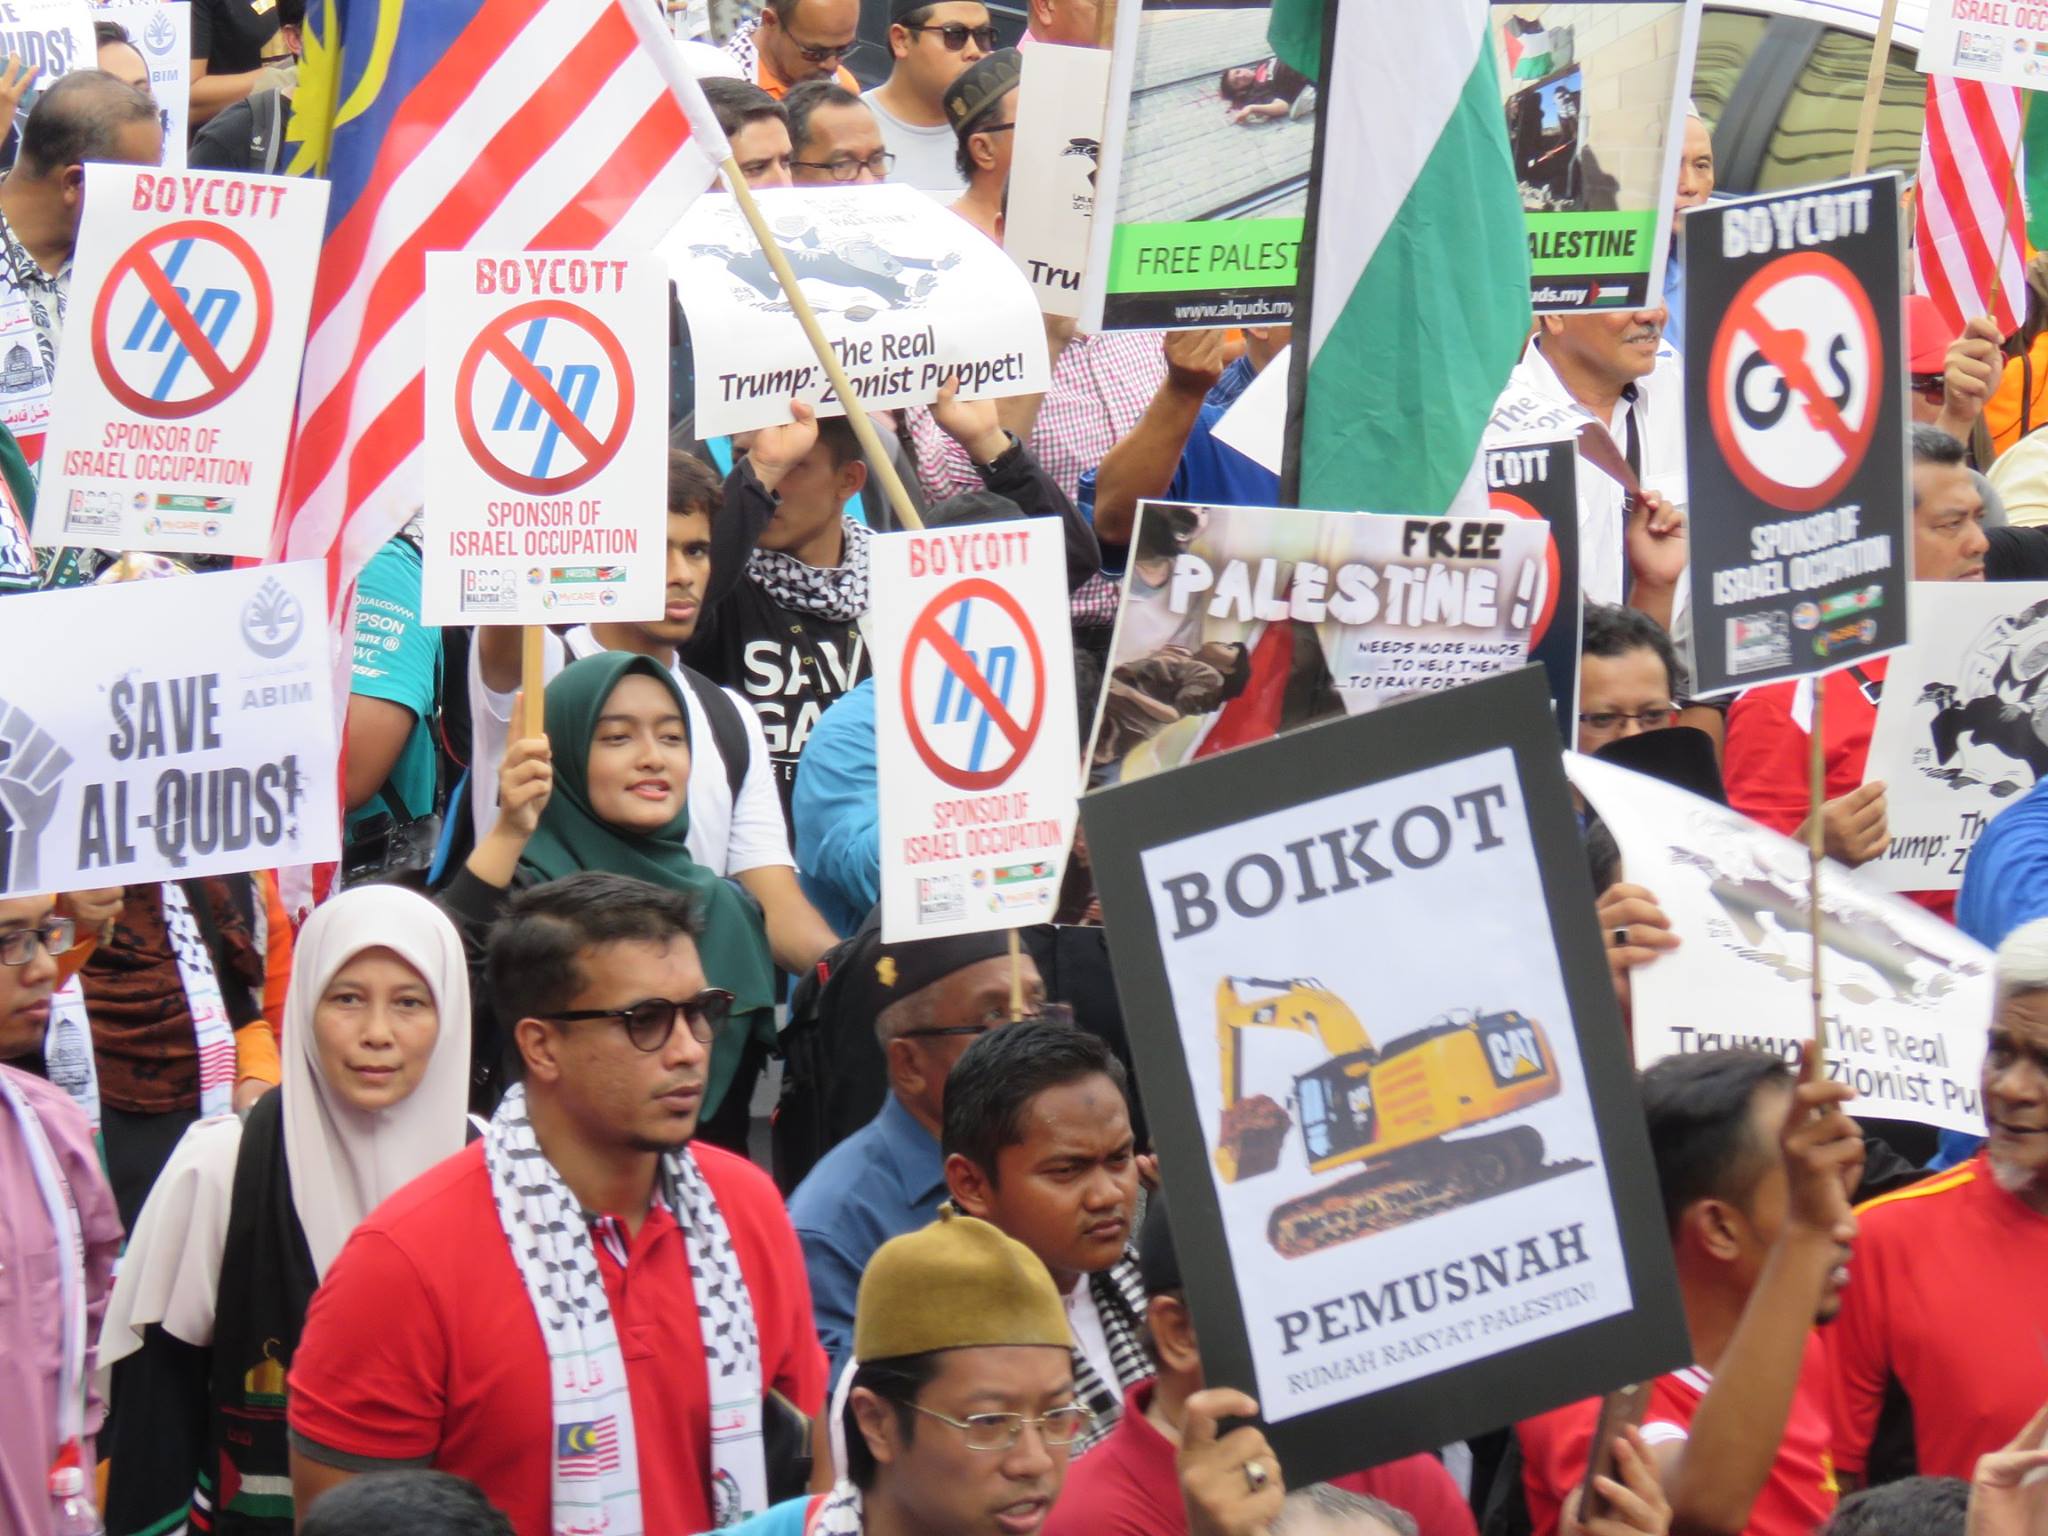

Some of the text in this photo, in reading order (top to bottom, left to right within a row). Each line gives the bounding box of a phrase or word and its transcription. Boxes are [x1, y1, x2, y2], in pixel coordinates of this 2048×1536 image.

[1952, 0, 2009, 26] ISRAEL
[152, 70, 179, 82] BIM
[132, 174, 287, 219] BOYCOTT
[1722, 189, 1872, 258] BOYCOTT
[476, 258, 628, 294] BOYCOTT
[1028, 259, 1080, 290] Tru
[1137, 246, 1200, 275] FREE
[882, 325, 935, 361] Real
[719, 352, 1024, 403] Trump: Zonist Puppet!
[103, 422, 220, 453] SPONSOR OF
[63, 451, 253, 486] ISRAEL OCCUPATION
[1486, 449, 1550, 488] COTT
[487, 500, 601, 527] SPONSOR OF
[450, 529, 638, 556] ISRAEL OCCUPATION
[908, 531, 1030, 577] BOYCOTT
[1402, 520, 1504, 559] FREE
[356, 612, 405, 634] PSON
[1359, 641, 1521, 655] NEEDS MORE HANDS
[240, 682, 312, 710] ABIM
[1375, 677, 1414, 689] PRAY
[109, 673, 222, 761] SAVE
[76, 755, 300, 870] AL-QUDS!
[903, 819, 1062, 864] ISRAEL OCCUPATION
[1880, 835, 1950, 866] ump:
[1162, 785, 1508, 940] BOIKOT
[1487, 1027, 1542, 1079] CAT
[1882, 1026, 1950, 1067] Real
[1823, 1060, 1936, 1105] Zionist
[1275, 1222, 1590, 1355] PEMUSNAH
[1286, 1283, 1597, 1395] RUMAH RAKYAT PALESTIN!
